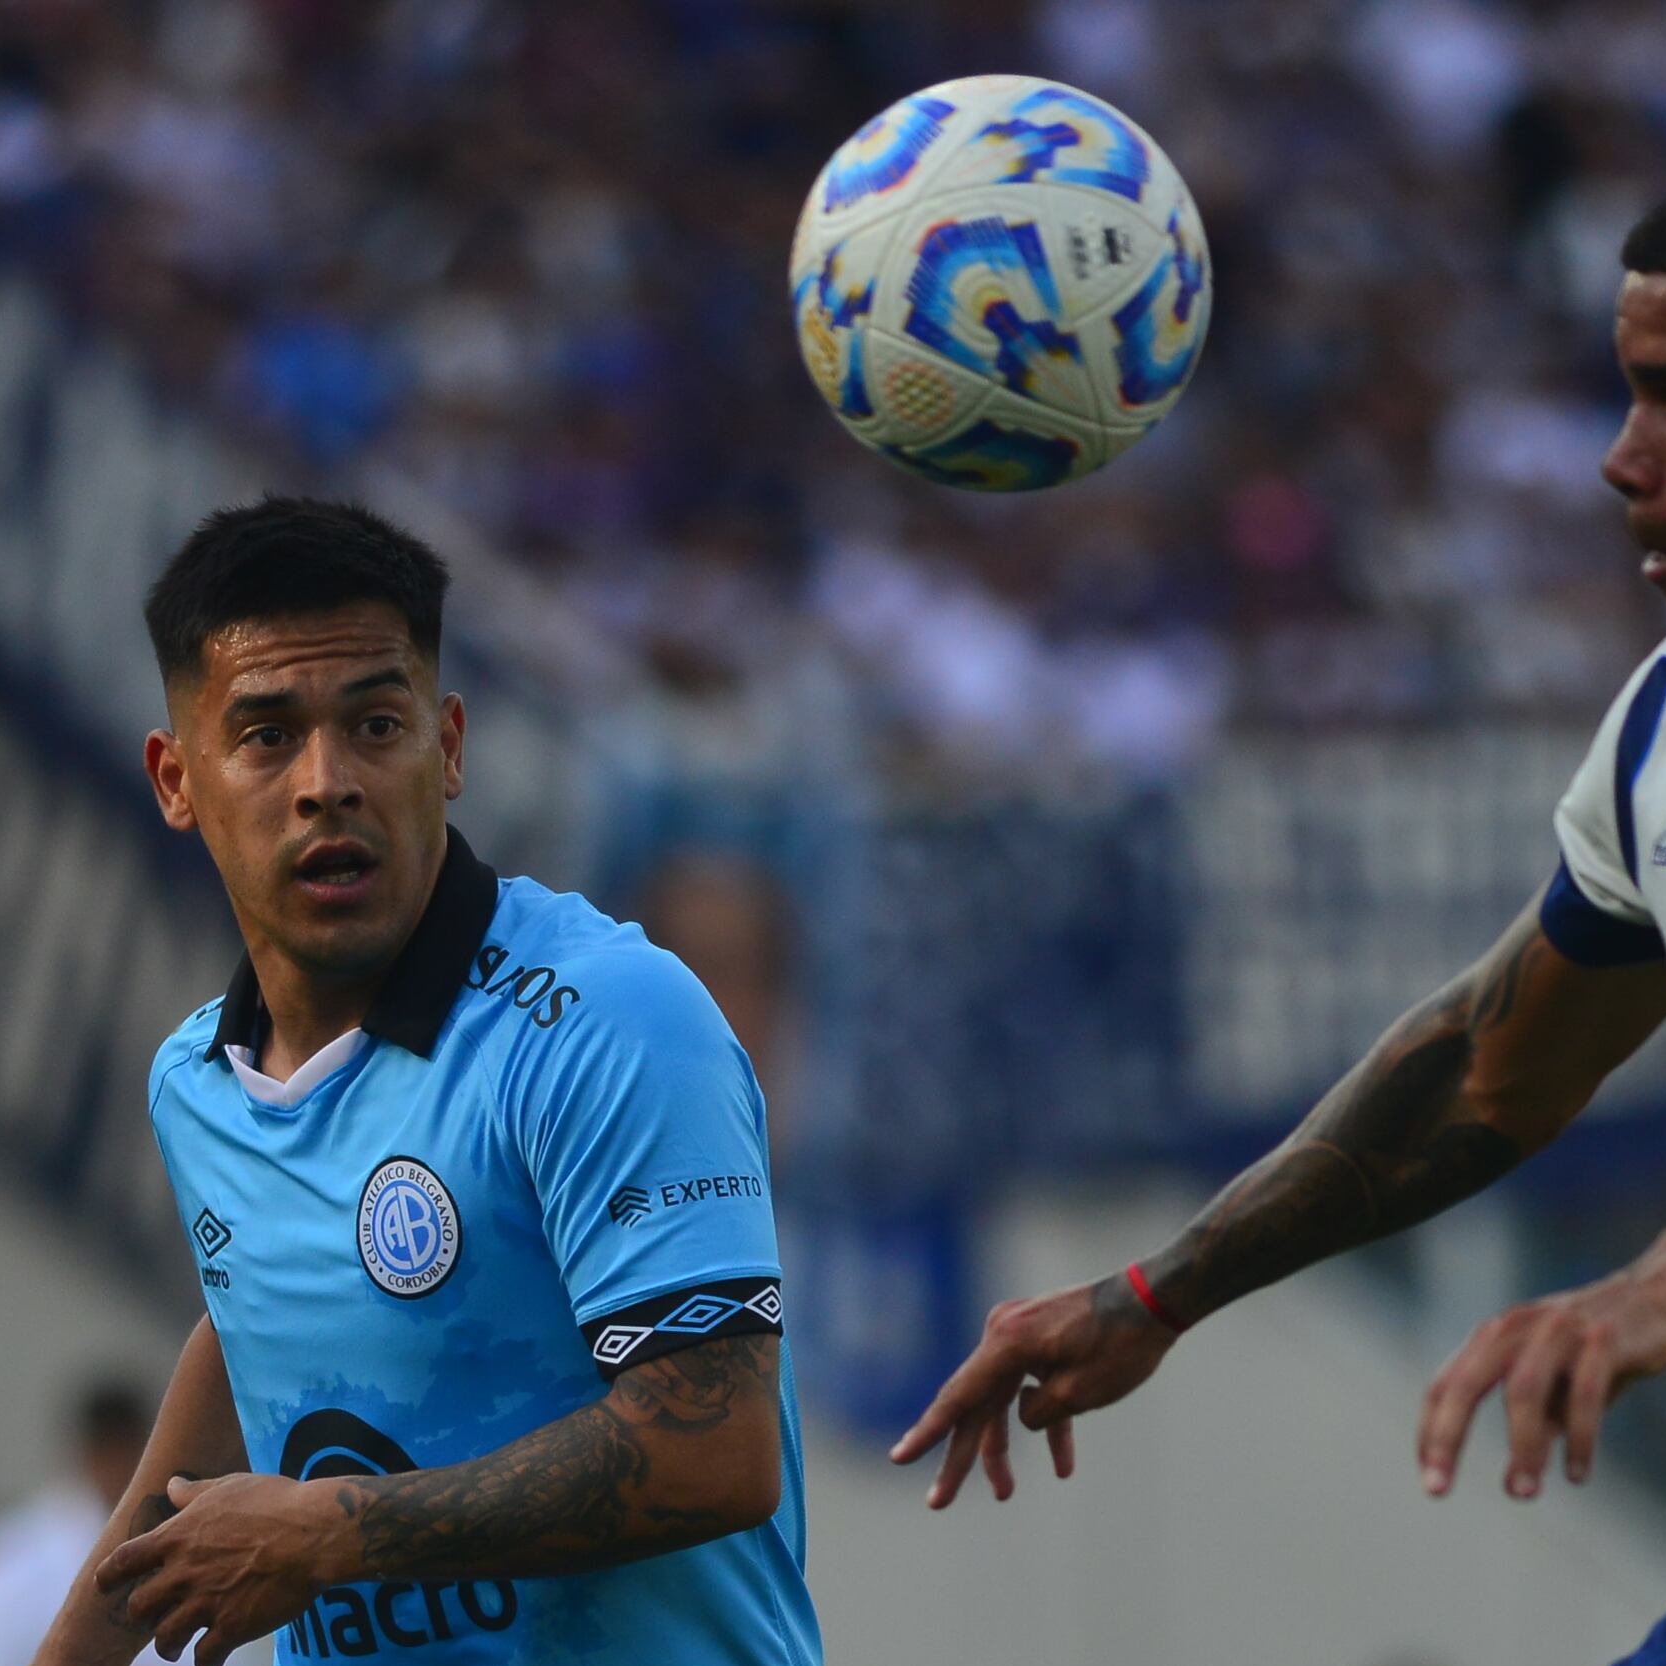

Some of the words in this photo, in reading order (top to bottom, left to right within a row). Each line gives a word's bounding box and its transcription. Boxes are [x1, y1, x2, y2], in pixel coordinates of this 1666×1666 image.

[660, 1175, 762, 1208] EXPERTO
[363, 1223, 378, 1265] CLUB
[408, 1167, 454, 1243] BELGRANO
[387, 1260, 446, 1289] CORDOBA
